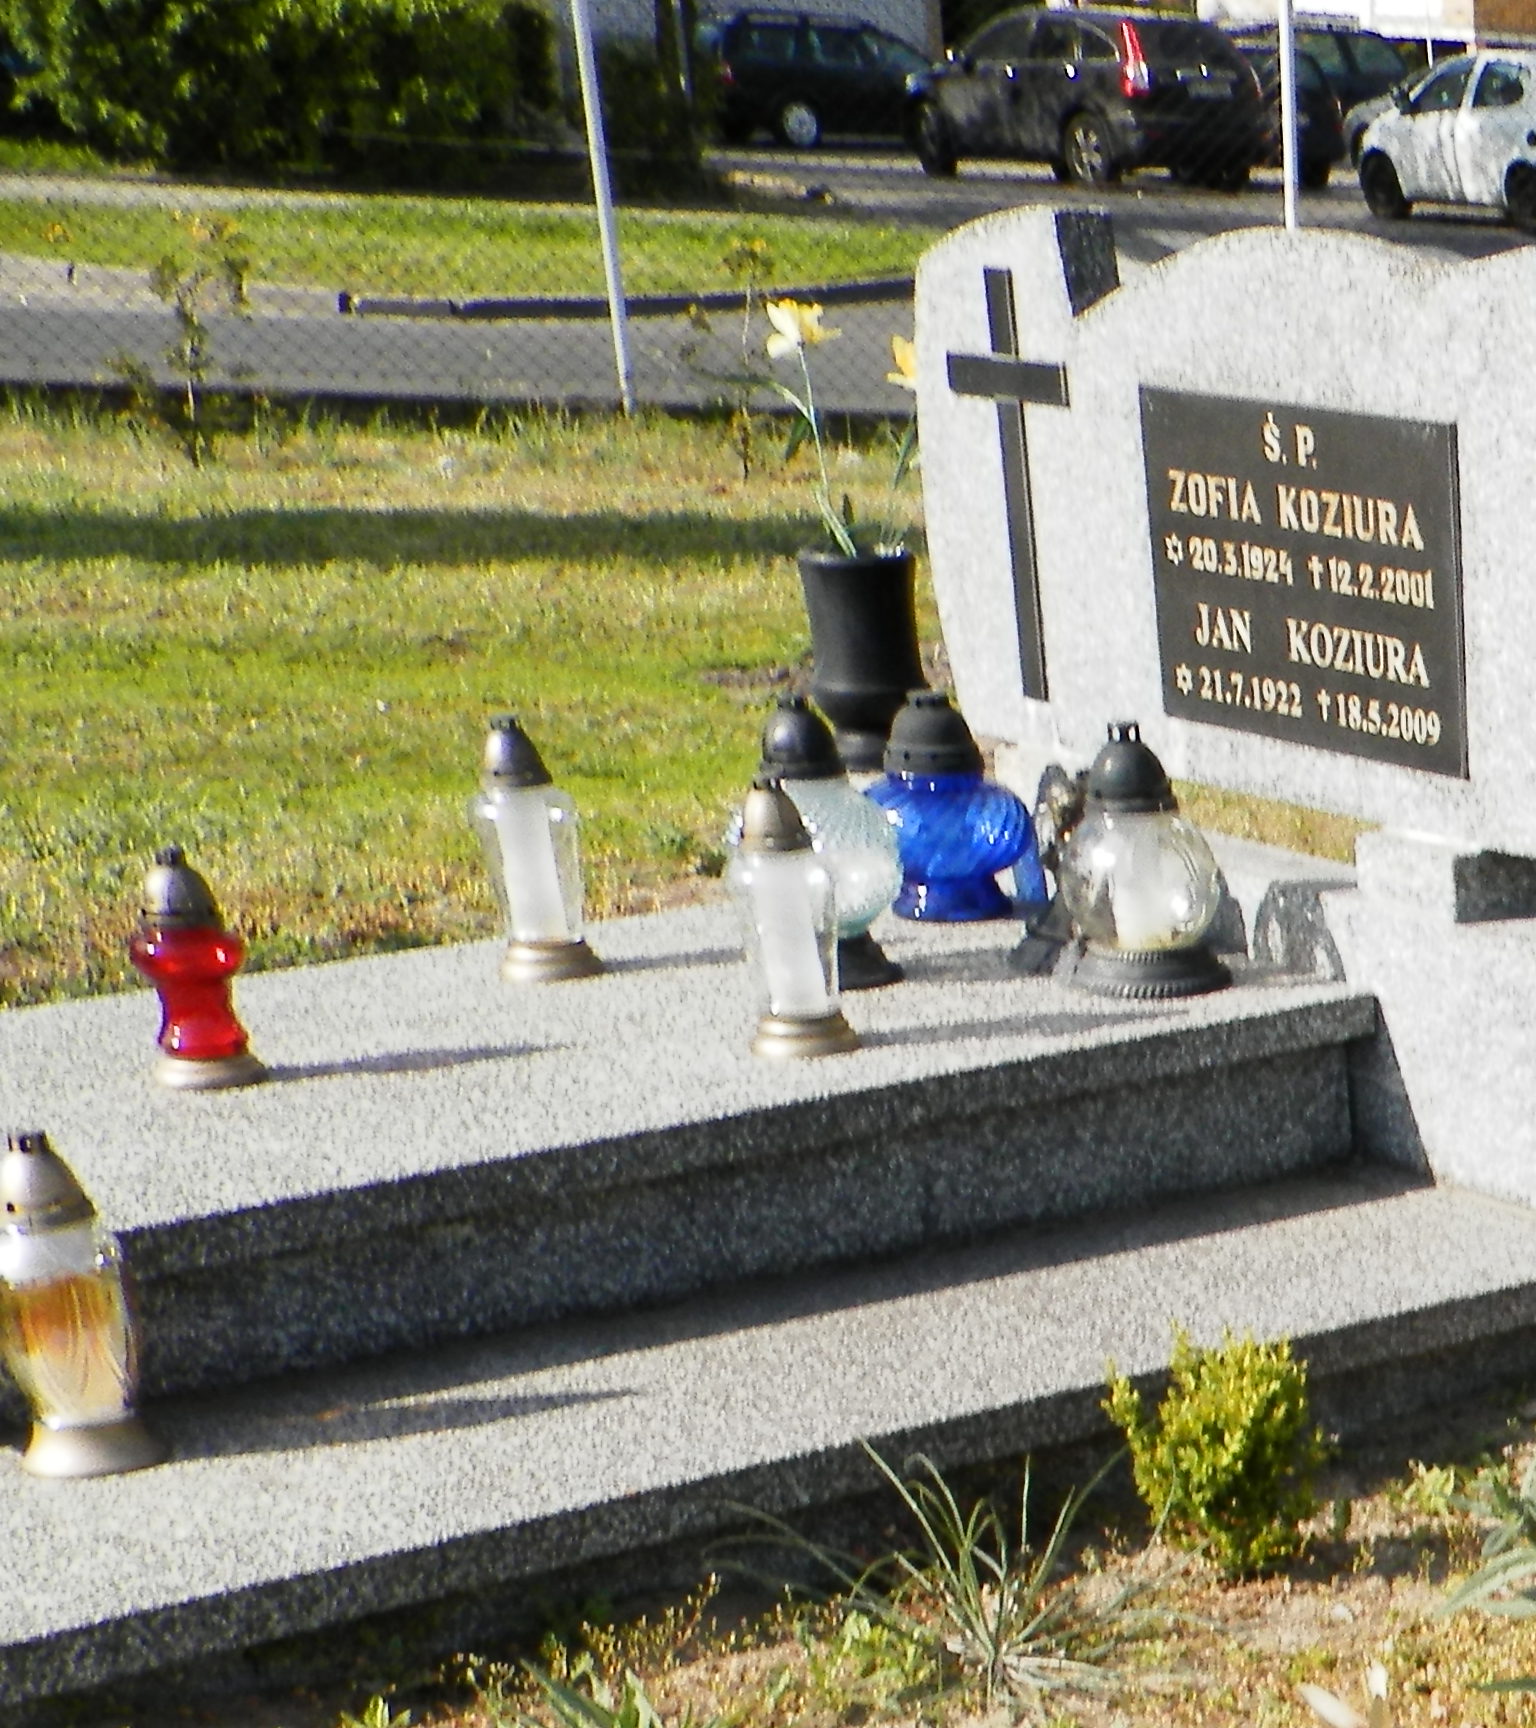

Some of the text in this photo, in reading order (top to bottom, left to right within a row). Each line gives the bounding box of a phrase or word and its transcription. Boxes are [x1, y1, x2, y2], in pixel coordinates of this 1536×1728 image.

[1167, 468, 1425, 551] ZOFIA KOZIURA
[1187, 535, 1435, 610] 20.3.1924 12.2.2001
[1195, 602, 1431, 688] JAN KOZIURA
[1199, 665, 1442, 746] 21.7.1922 18.5.2009
